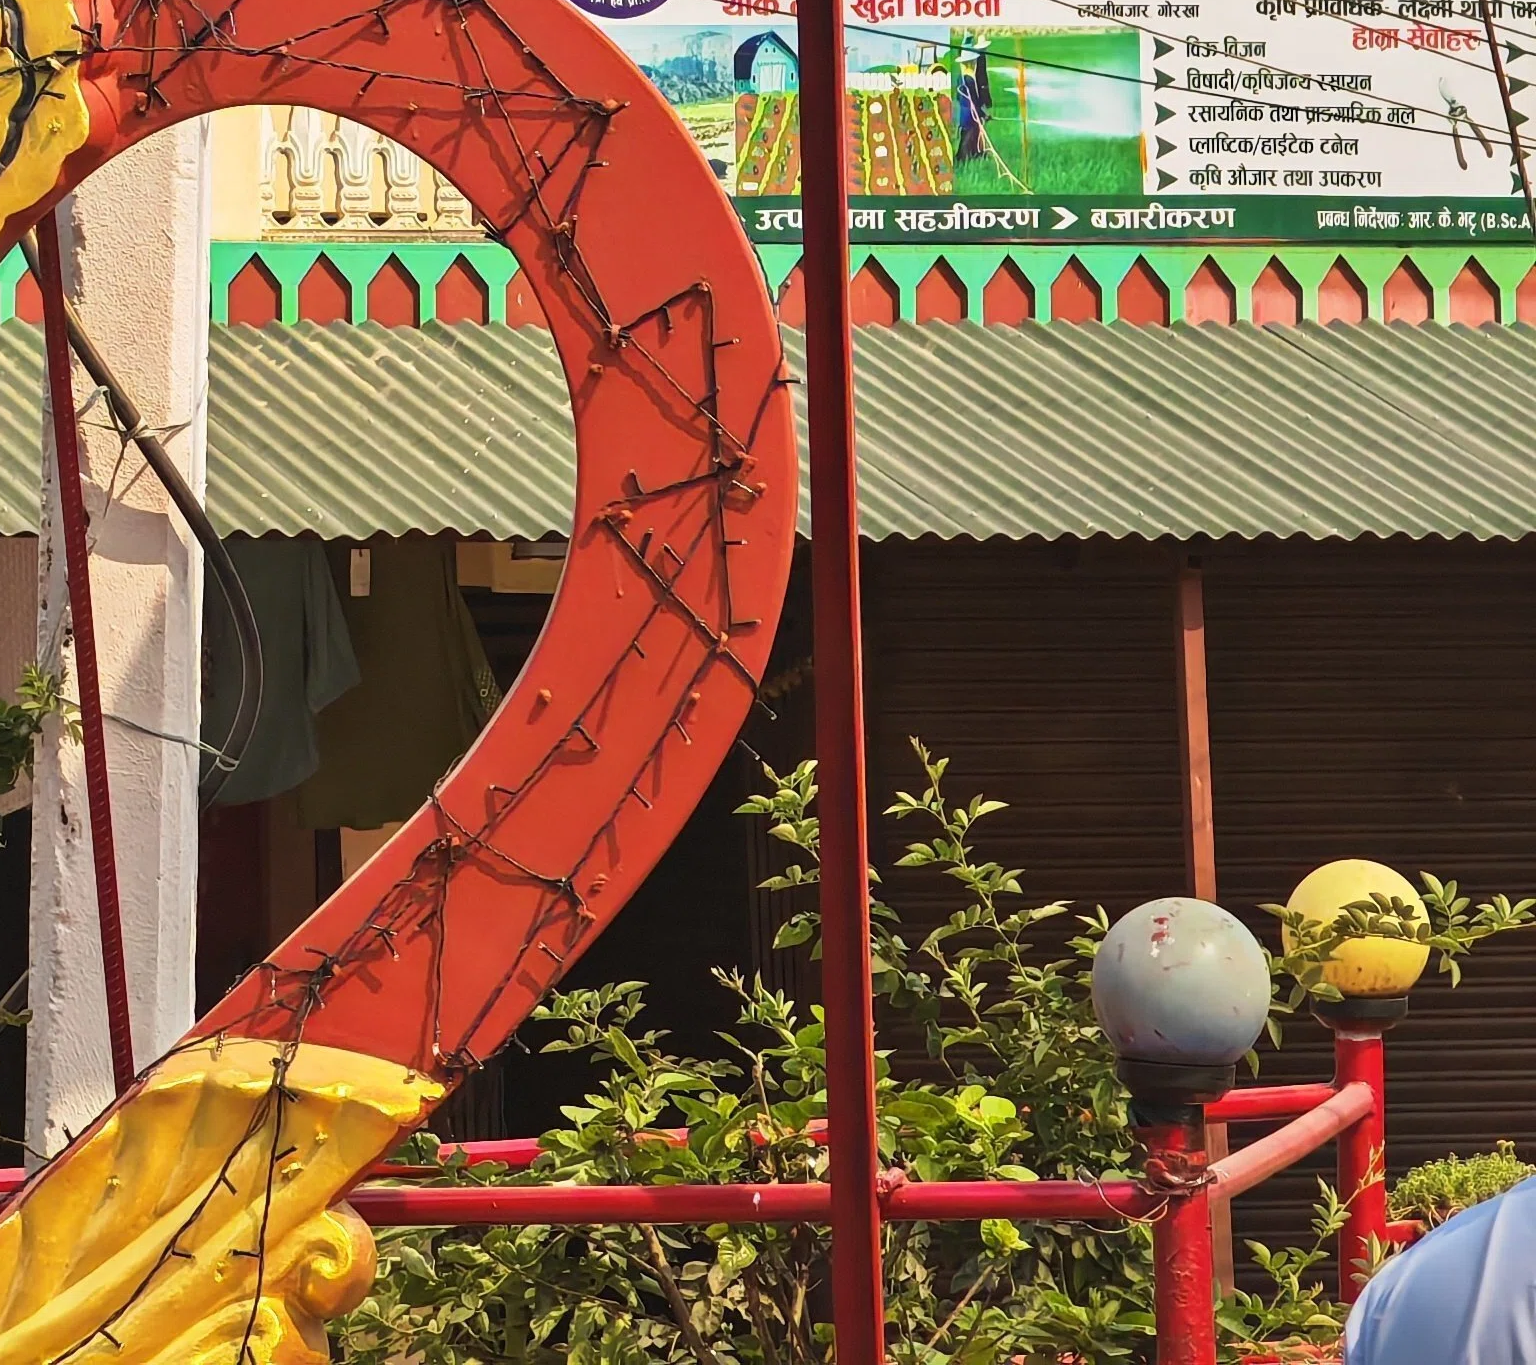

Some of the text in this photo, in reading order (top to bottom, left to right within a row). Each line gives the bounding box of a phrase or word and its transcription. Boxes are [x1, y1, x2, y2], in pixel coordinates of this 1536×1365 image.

[1157, 0, 1200, 19] गोरखा
[1386, 105, 1416, 125] मल
[1319, 132, 1360, 156] टनेल
[1188, 162, 1383, 191] कृषि औजार तथा उपकरण
[894, 203, 1041, 234] सहजीकरण
[1090, 203, 1236, 231] बजारीकरण
